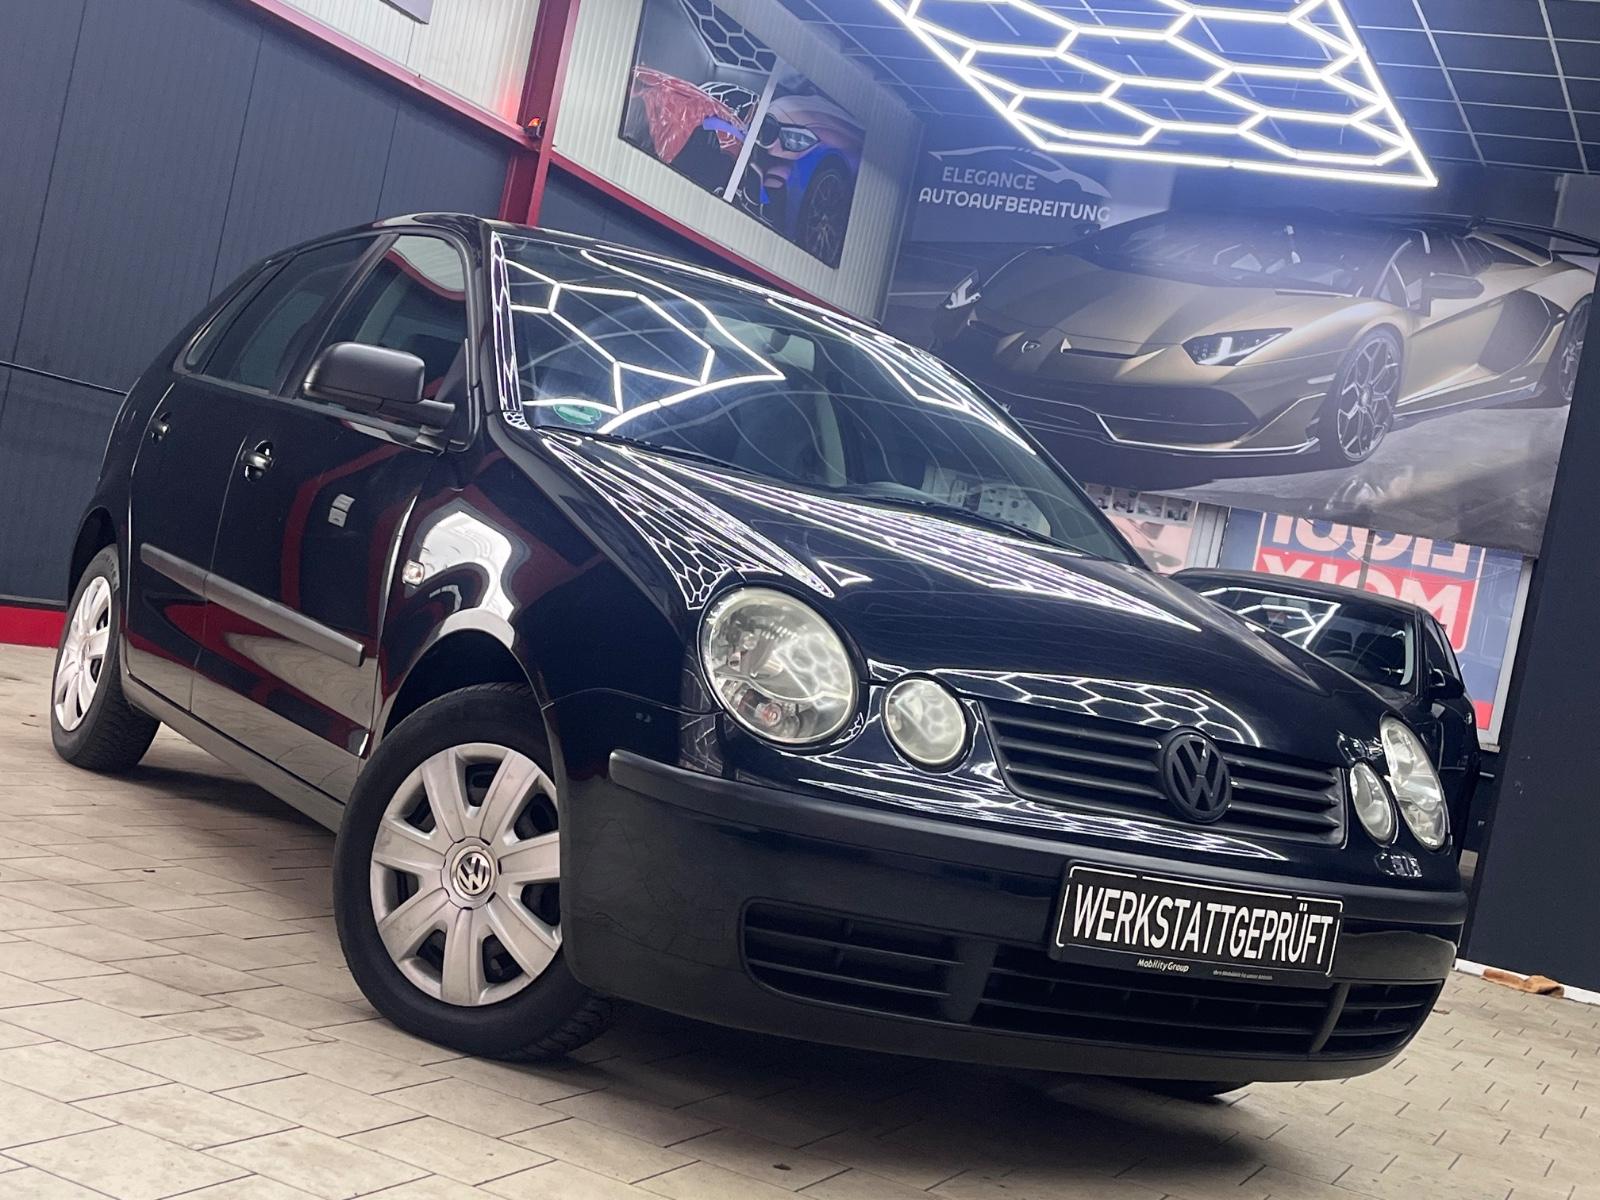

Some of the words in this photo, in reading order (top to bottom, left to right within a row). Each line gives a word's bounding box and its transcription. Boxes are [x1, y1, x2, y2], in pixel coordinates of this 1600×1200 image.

[942, 166, 1038, 191] ELEGANCE
[918, 187, 1112, 222] AUTOAUFBEREITUNG
[1072, 884, 1333, 965] WERKSTATTGEPRÜFT
